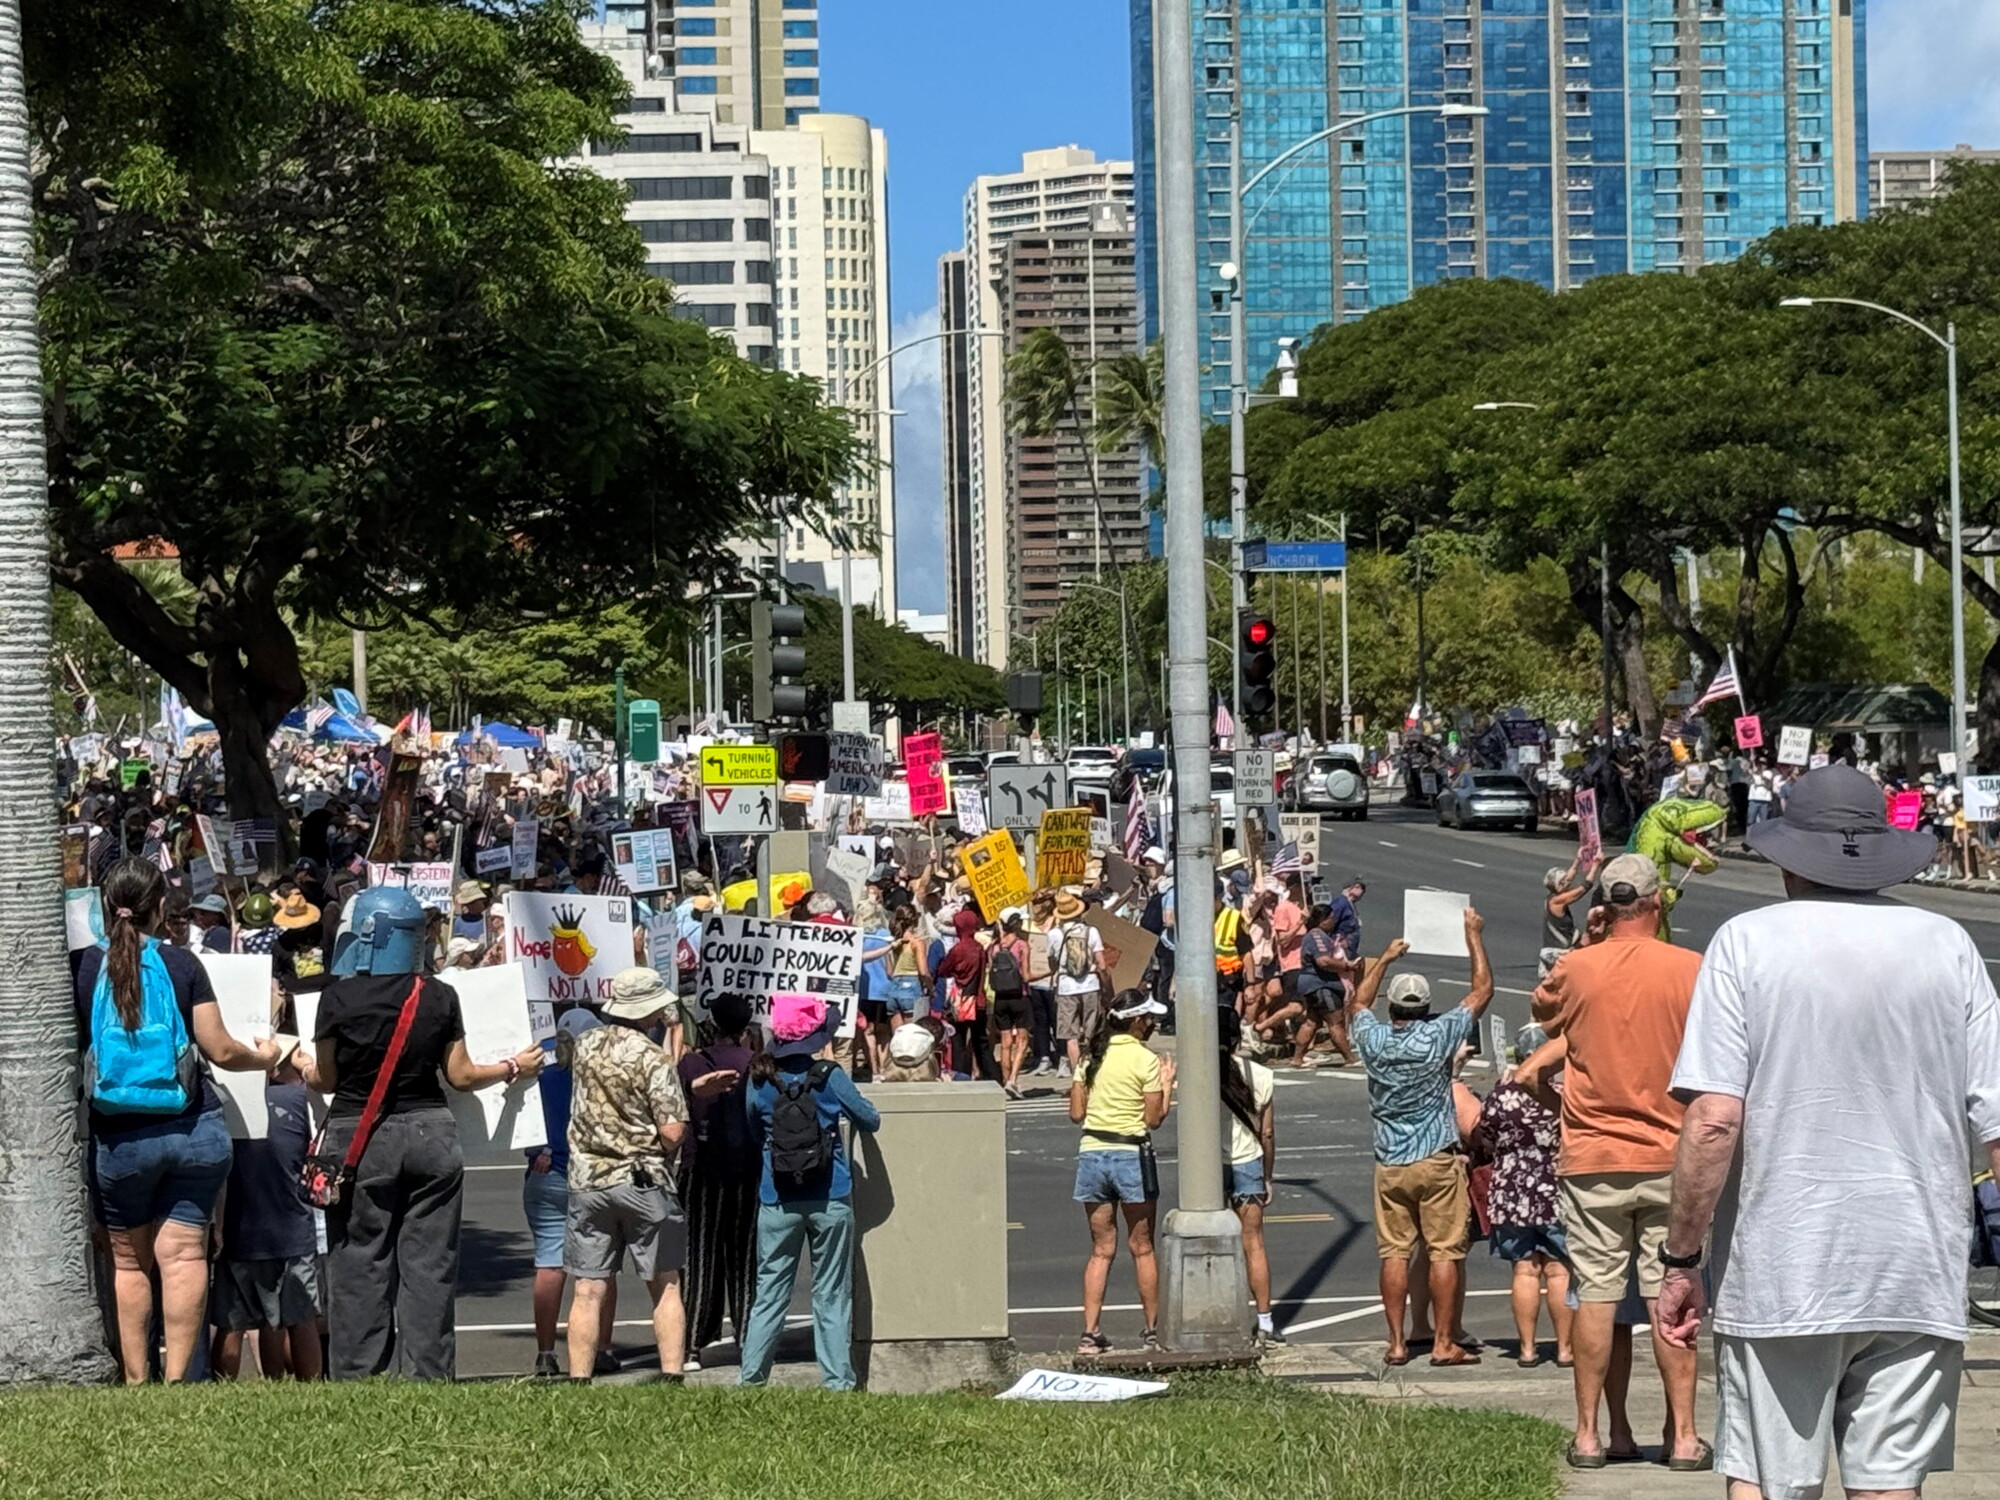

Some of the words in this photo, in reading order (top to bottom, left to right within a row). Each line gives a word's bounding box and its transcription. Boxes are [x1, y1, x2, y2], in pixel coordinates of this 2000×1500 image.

[1267, 555, 1320, 566] NCHBOWL
[1788, 730, 1804, 739] NO
[728, 753, 771, 765] TURNING
[838, 746, 867, 759] MEET
[1246, 754, 1263, 766] NO
[727, 769, 772, 780] VEHICLES
[829, 759, 882, 777] AMERICA!
[1242, 768, 1265, 777] LEFT
[1237, 779, 1258, 787] TURN
[1260, 779, 1272, 787] ON
[1245, 789, 1263, 798] RED
[738, 803, 751, 814] TO
[1577, 795, 1593, 817] NO
[1005, 816, 1032, 826] ONLY
[1045, 836, 1062, 849] FOR
[1064, 835, 1086, 848] THE
[1042, 850, 1087, 876] TRIALS
[705, 917, 725, 936] A
[741, 918, 857, 947] LITTERBOX
[513, 926, 551, 969] Nope
[702, 941, 764, 966] COULD
[772, 948, 853, 976] PRODUCE
[701, 966, 714, 987] A
[723, 968, 799, 991] BETTER
[548, 976, 580, 998] NOT
[583, 979, 591, 998] A
[597, 977, 614, 998] KI
[1026, 1373, 1108, 1394] NOT
